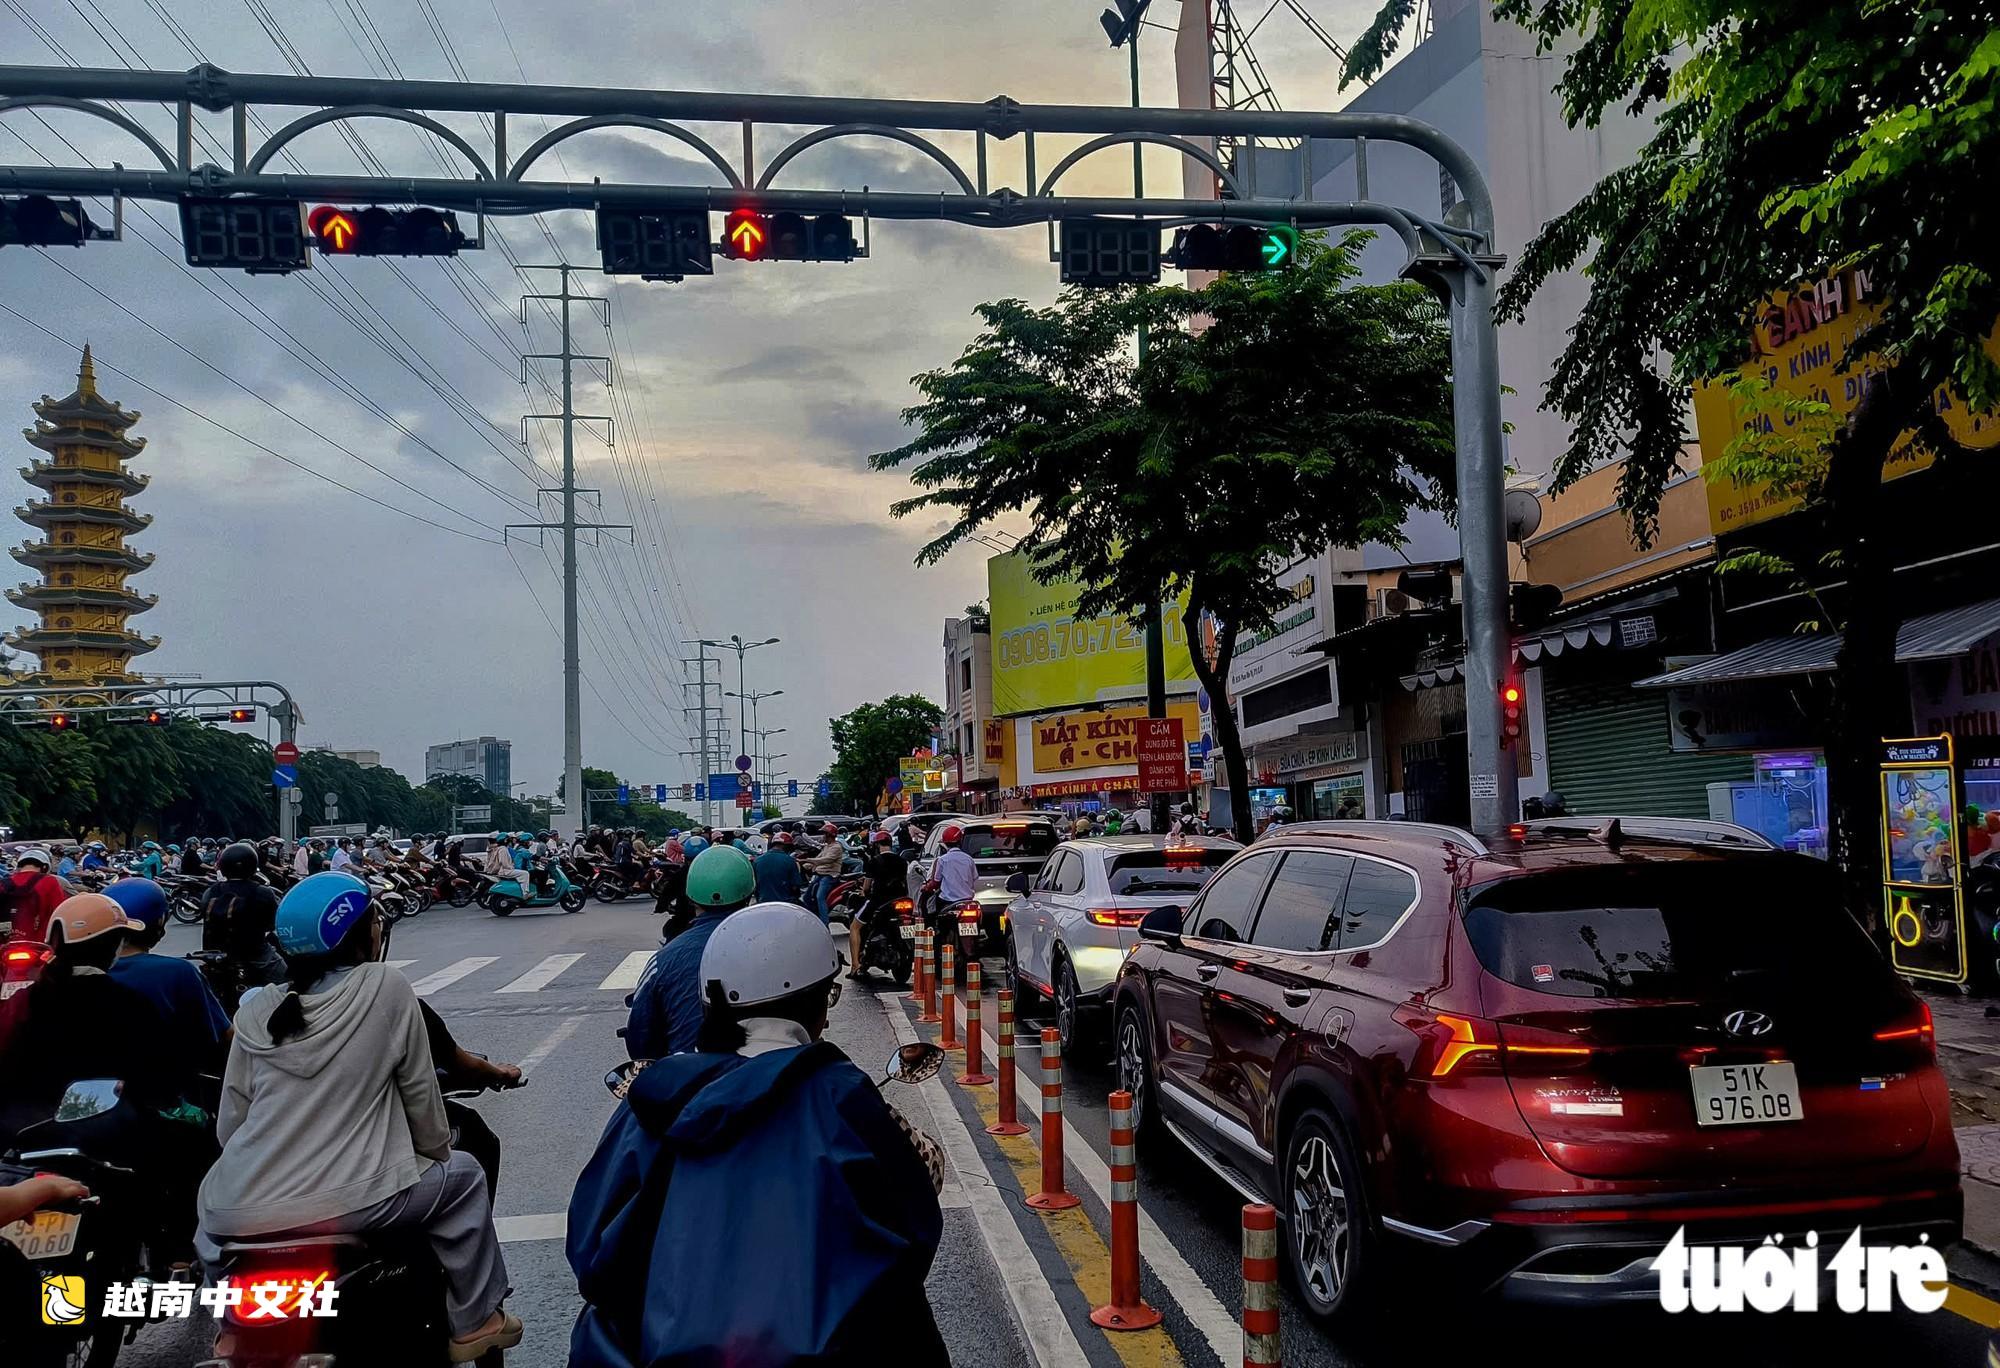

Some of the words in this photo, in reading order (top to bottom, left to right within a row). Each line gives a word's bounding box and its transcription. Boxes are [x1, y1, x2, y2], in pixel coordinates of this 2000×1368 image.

[1789, 341, 1830, 379] KÍNH
[998, 606, 1181, 669] 0908.70.72.1
[1150, 720, 1170, 735] CẤM
[1061, 782, 1087, 794] KÍNH
[1725, 1067, 1769, 1092] 51K
[1710, 1093, 1791, 1122] 976.08
